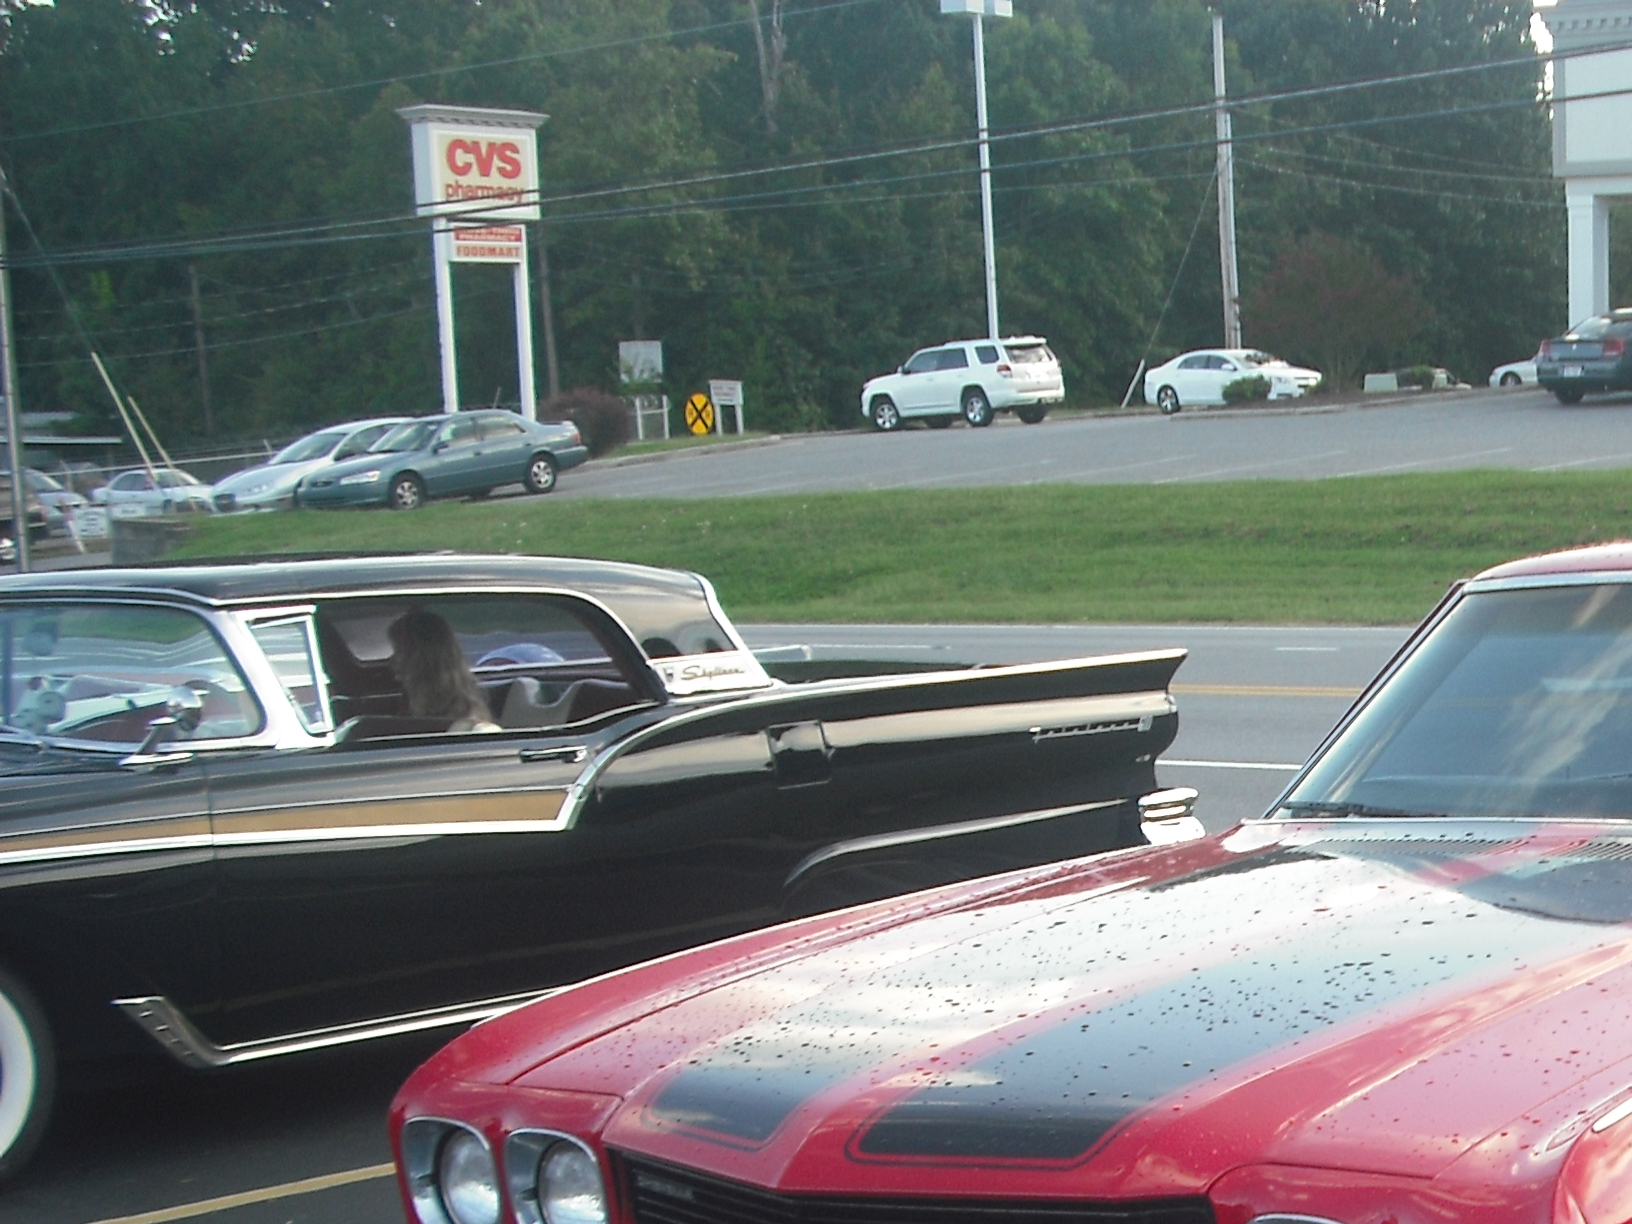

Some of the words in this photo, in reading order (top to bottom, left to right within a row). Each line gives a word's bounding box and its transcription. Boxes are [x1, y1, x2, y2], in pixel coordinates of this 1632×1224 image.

[446, 138, 521, 179] CVS
[446, 181, 523, 203] pharmacy
[456, 246, 520, 257] FOODMART
